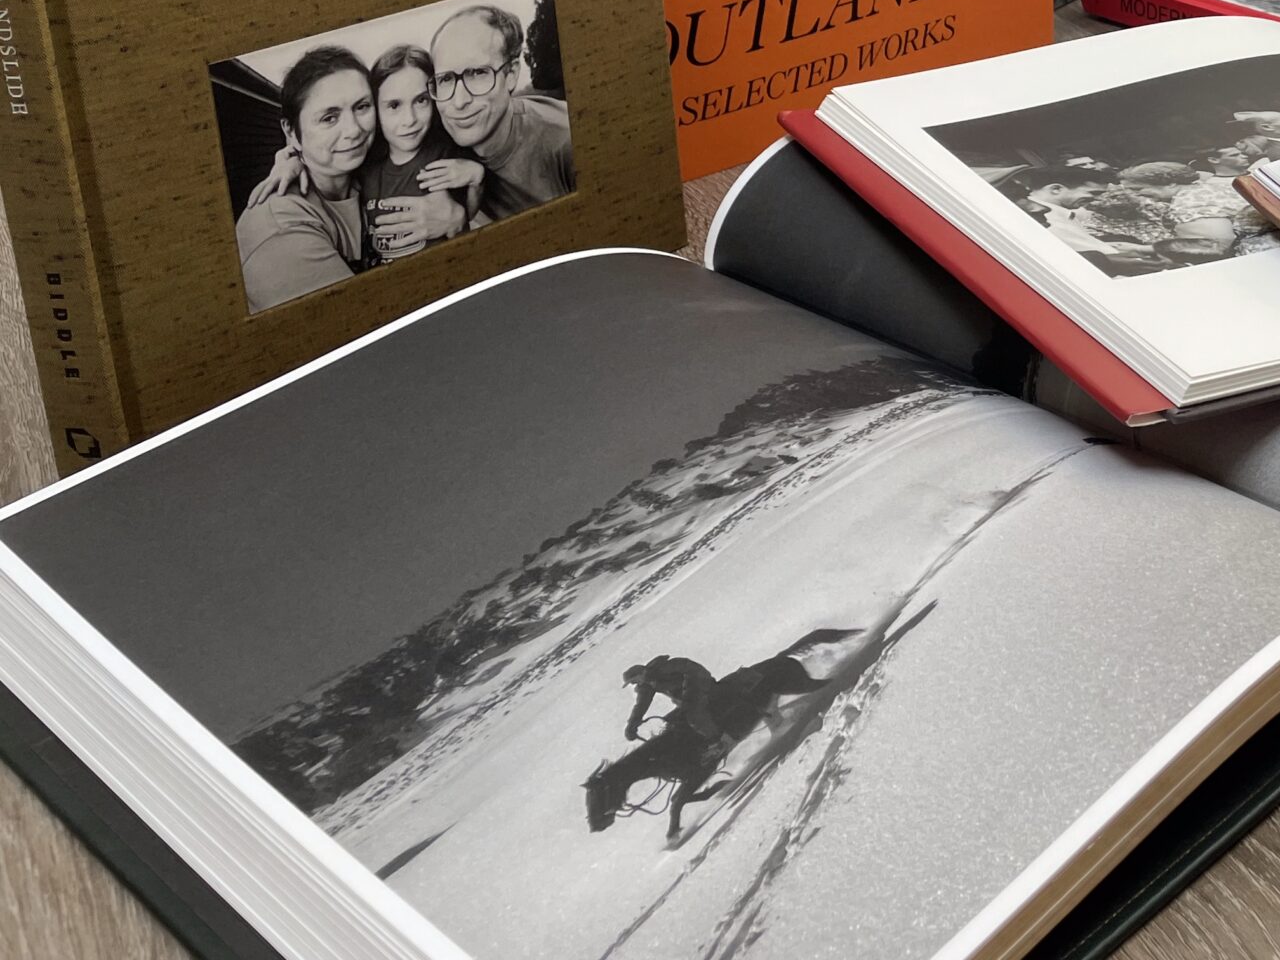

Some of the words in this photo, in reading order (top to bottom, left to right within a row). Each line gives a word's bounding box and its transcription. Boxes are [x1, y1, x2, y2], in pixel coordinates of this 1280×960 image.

[678, 52, 847, 126] SELECTED
[857, 15, 956, 72] WORKS
[45, 272, 81, 380] BIDDLE
